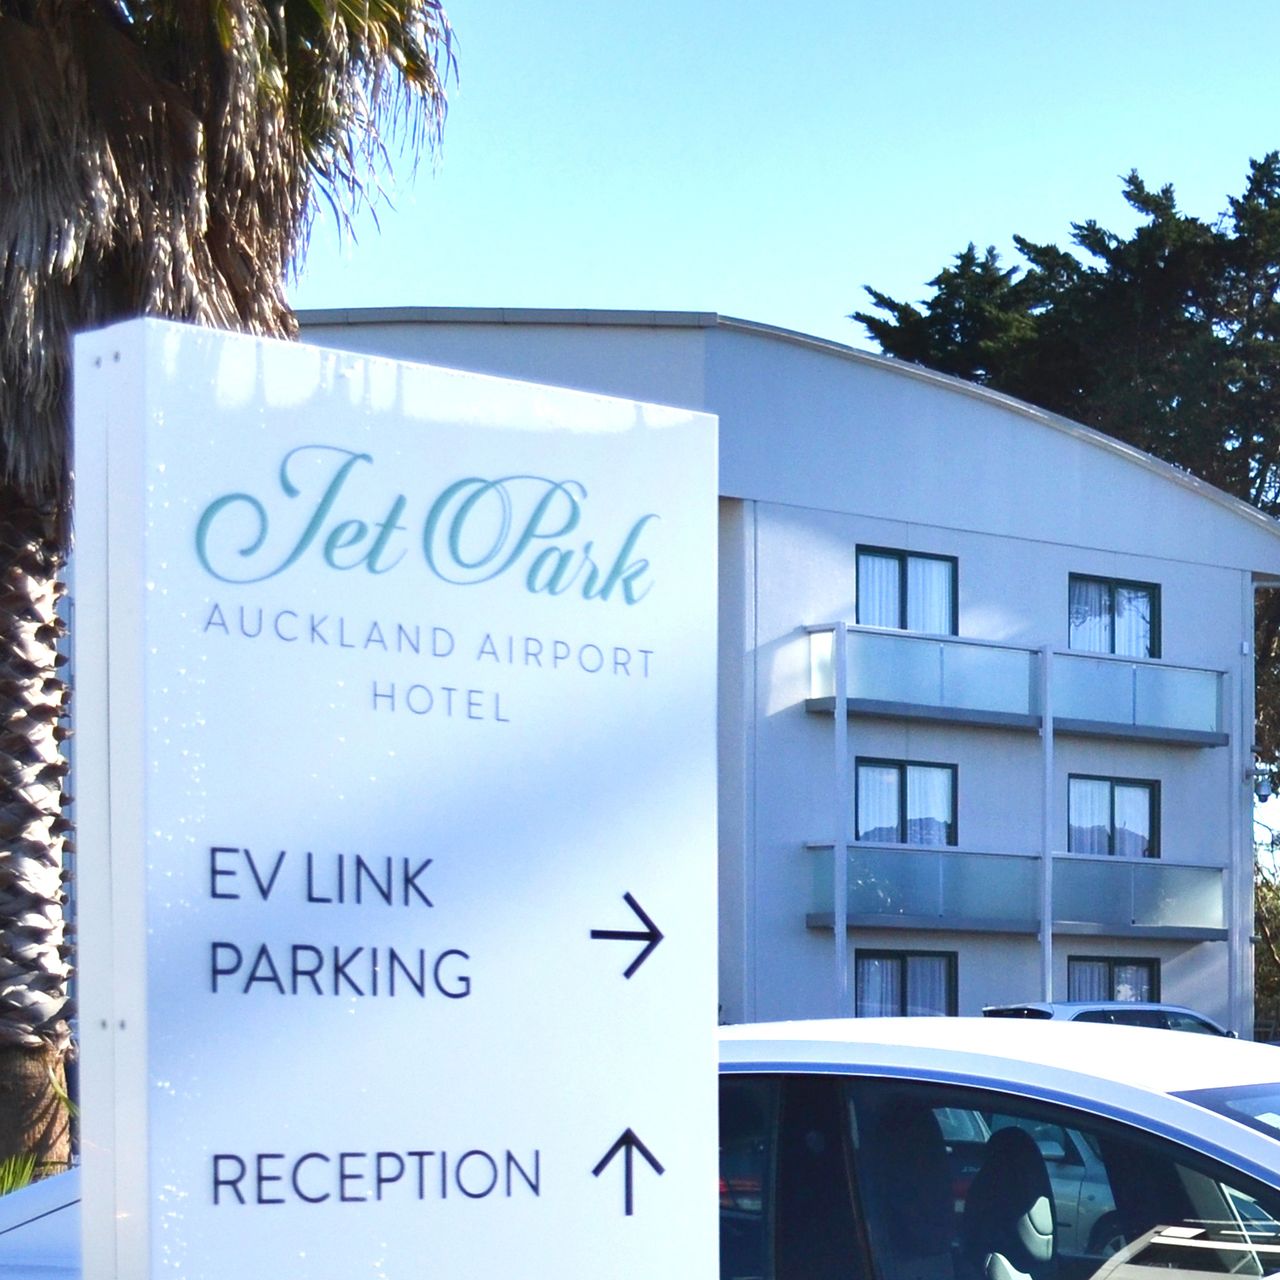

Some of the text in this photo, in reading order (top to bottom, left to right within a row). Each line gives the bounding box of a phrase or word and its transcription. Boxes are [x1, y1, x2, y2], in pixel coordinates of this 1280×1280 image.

[194, 444, 661, 606] Jet Park
[203, 603, 655, 678] AUCKLAND AIRPORT
[372, 681, 510, 722] HOTEL
[208, 846, 434, 908] EV LINK
[209, 940, 472, 999] PARKING
[212, 1149, 540, 1206] RECEPTION
